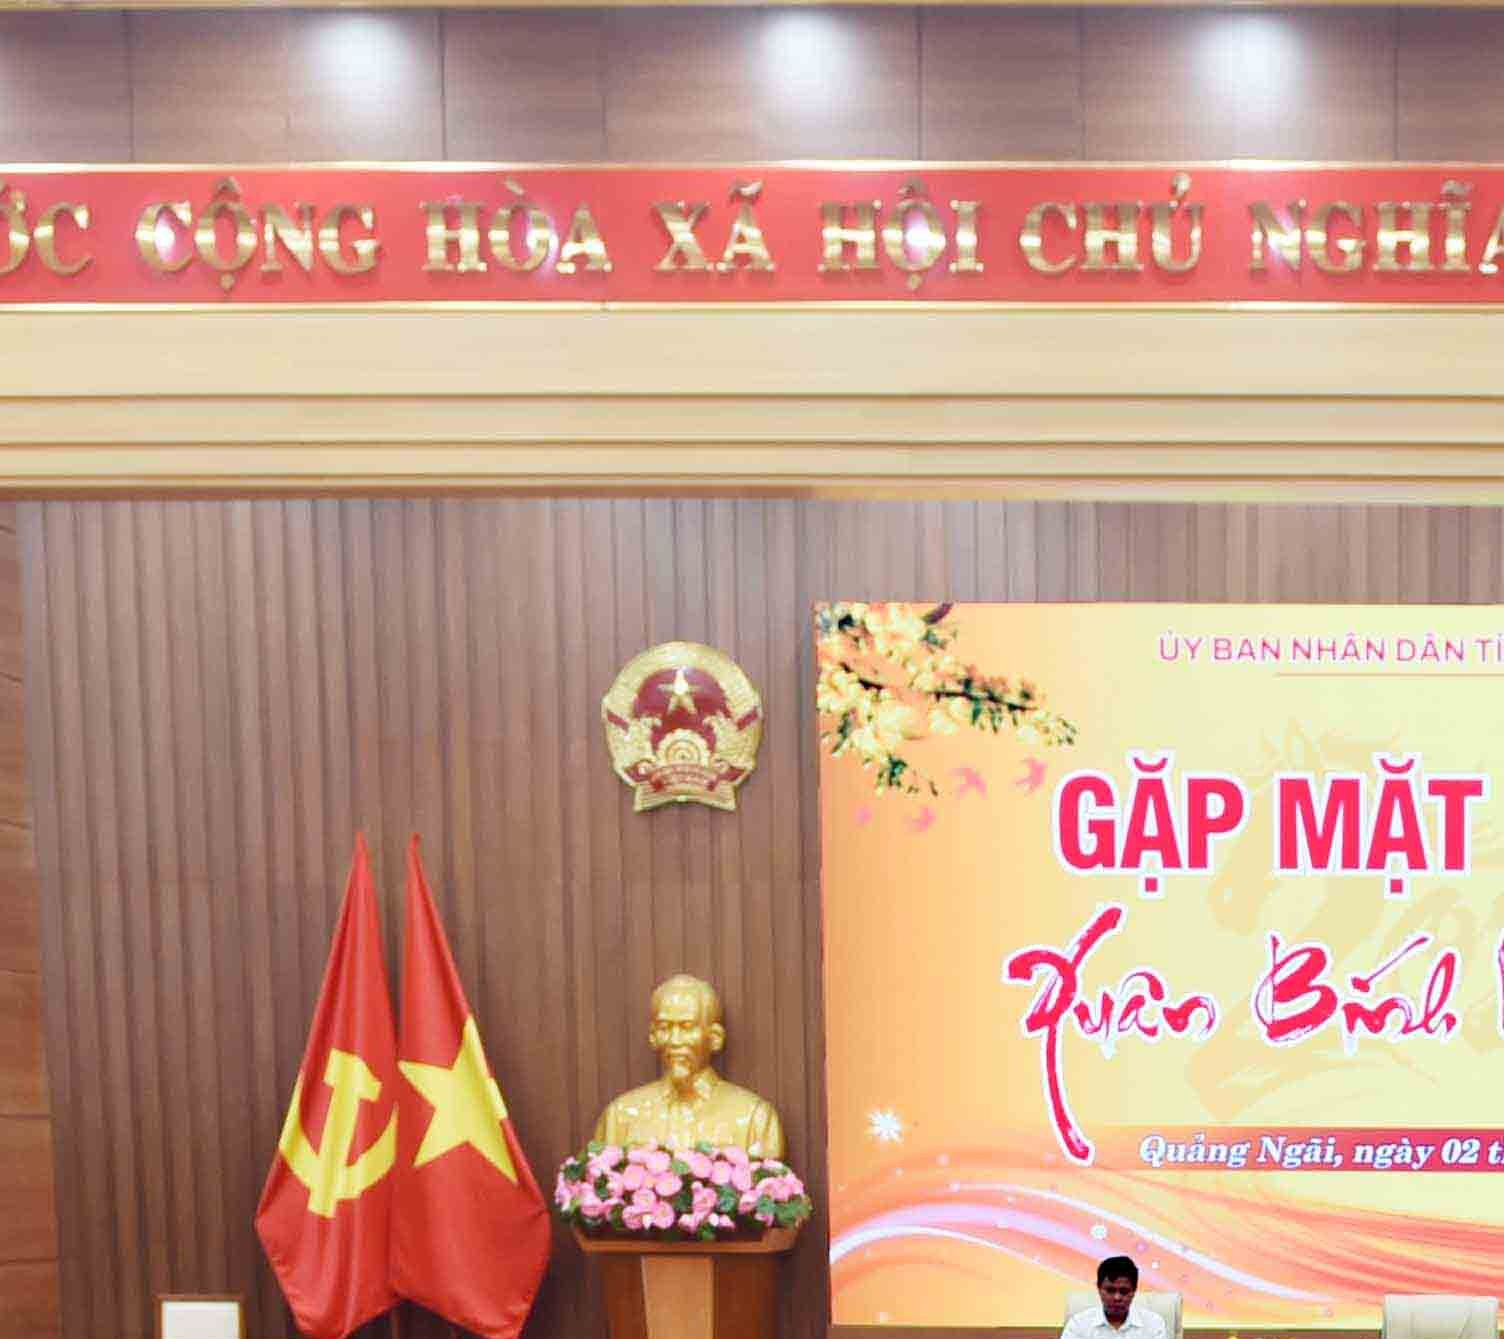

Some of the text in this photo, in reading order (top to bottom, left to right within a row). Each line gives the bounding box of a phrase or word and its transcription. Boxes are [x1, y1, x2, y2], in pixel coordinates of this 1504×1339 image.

[134, 175, 382, 292] CỘNG
[420, 177, 614, 273] HÒA
[651, 178, 776, 273] XÃ
[817, 176, 985, 291] HỘI
[1019, 172, 1206, 275] CHỦ
[1211, 637, 1281, 662] BAN
[1290, 632, 1386, 662] NHÂN
[1396, 632, 1465, 663] DÂN
[1057, 756, 1245, 893] GẶP
[1278, 758, 1483, 894] MẶT
[1009, 907, 1216, 1162] Xuân
[1253, 934, 1458, 1043] Bính
[1138, 1132, 1250, 1169] Quảng
[1256, 1135, 1345, 1169] Ngãi,
[1352, 1137, 1435, 1170] ngày
[1440, 1138, 1481, 1165] 02
